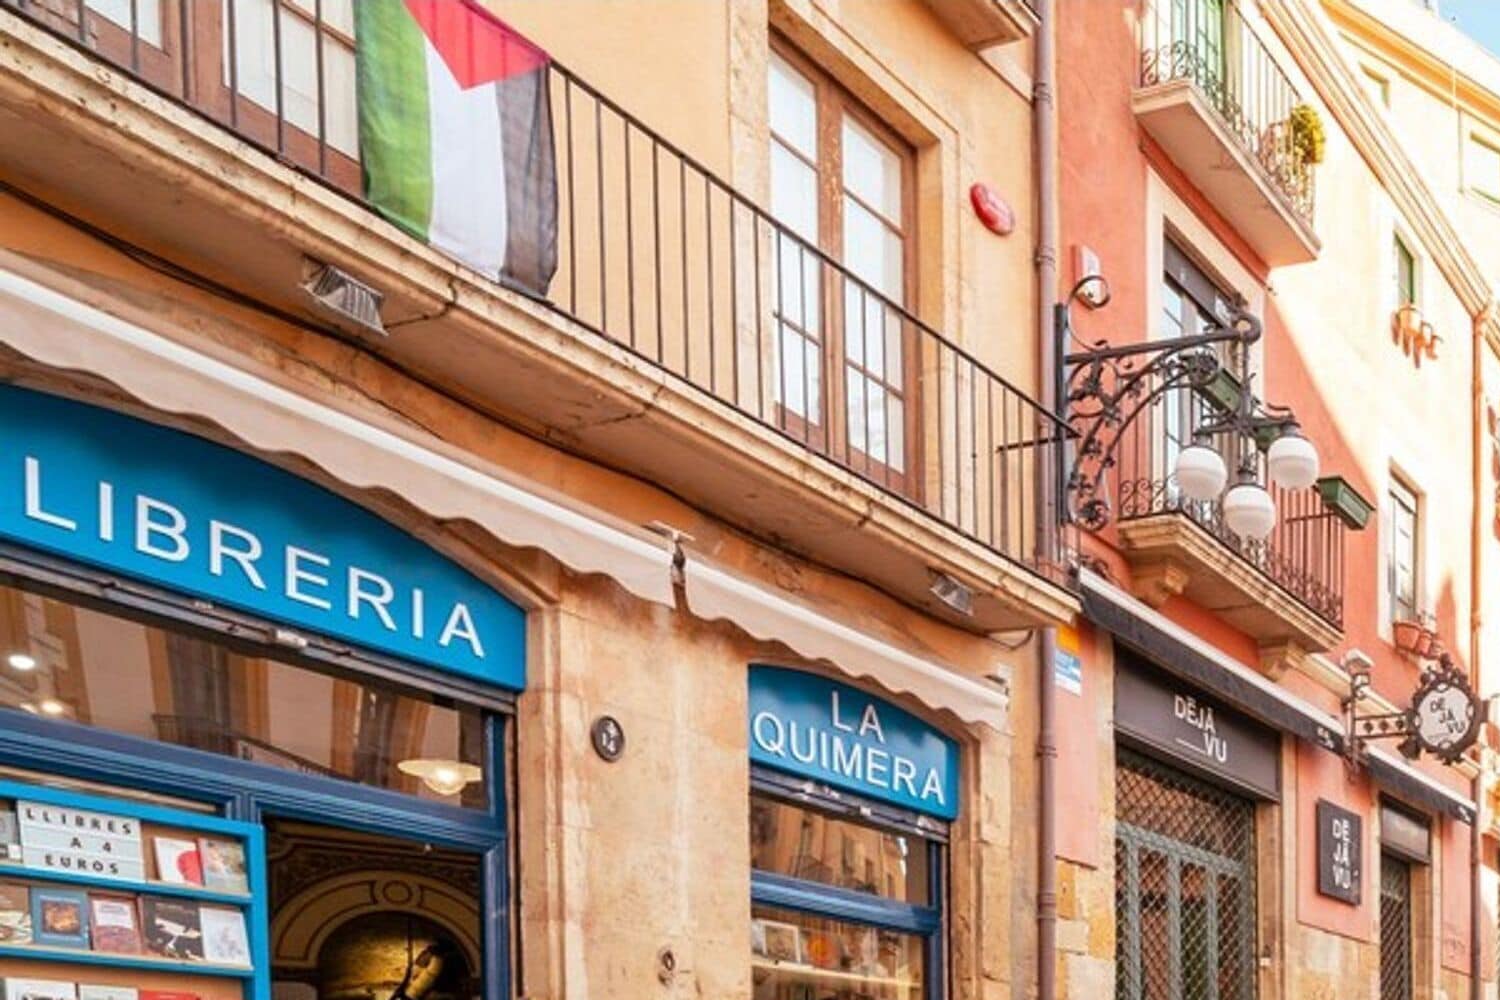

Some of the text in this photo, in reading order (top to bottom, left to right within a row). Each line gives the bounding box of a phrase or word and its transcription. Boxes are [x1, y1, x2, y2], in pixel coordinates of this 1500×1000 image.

[23, 456, 486, 659] LIBRERIA
[831, 690, 886, 744] LA
[752, 711, 945, 806] QUIMERA
[1202, 732, 1227, 763] VU
[25, 807, 131, 835] LLIBRES
[70, 836, 112, 853] A 4
[44, 853, 119, 875] EUROS
